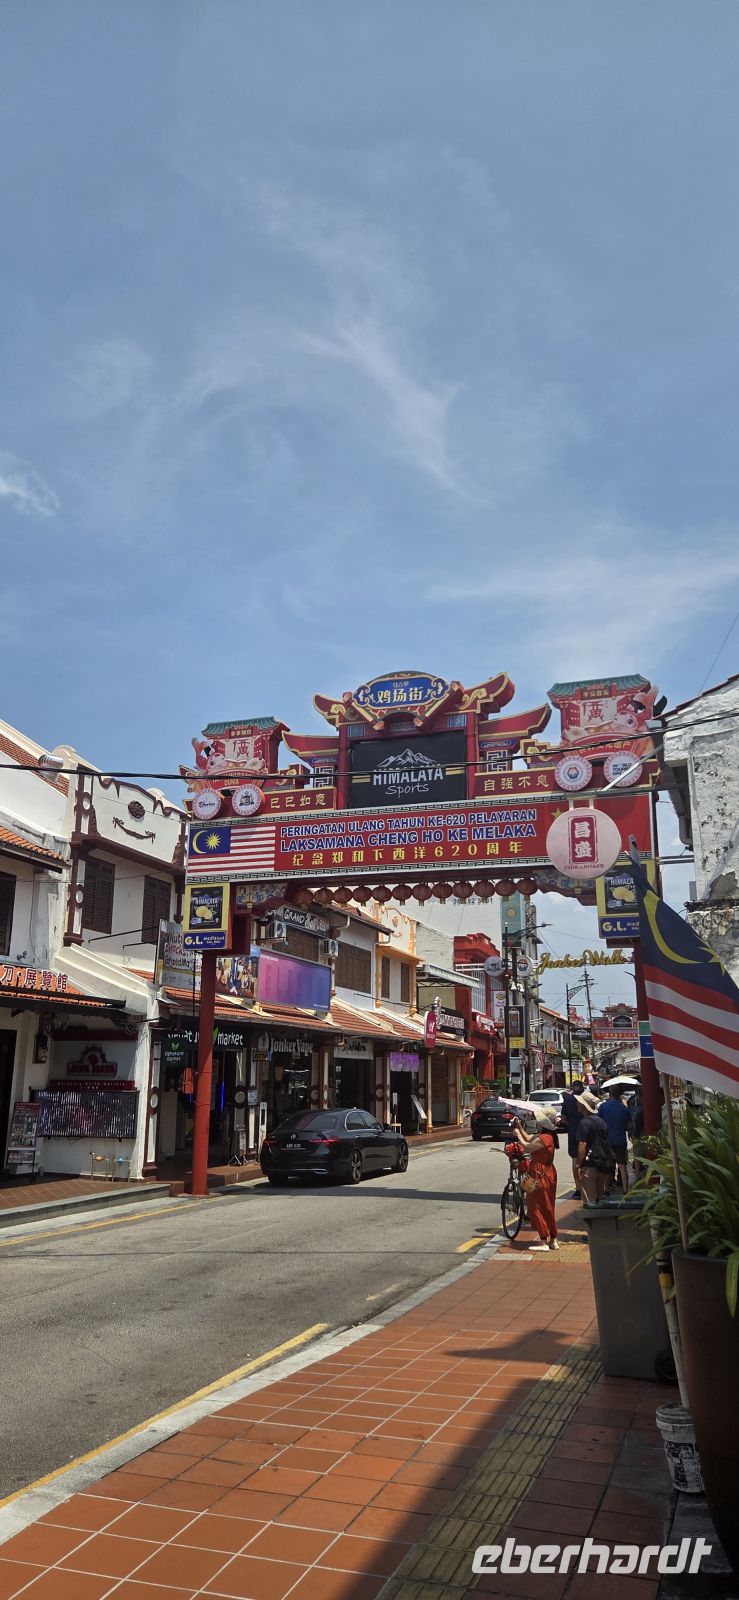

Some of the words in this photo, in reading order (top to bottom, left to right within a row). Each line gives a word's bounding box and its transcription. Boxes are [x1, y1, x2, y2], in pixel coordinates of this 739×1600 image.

[377, 686, 423, 704] 鸡场街
[373, 764, 443, 785] HIMALAYA
[483, 774, 550, 792] 自强不息
[386, 783, 429, 798] Sports
[281, 822, 345, 838] PERINGATAN
[347, 819, 385, 833] ULANG
[387, 817, 424, 831] TAHUN
[427, 814, 466, 828] KE-620
[468, 809, 537, 825] PELAYARAN
[280, 835, 365, 853] LAKSAMANA
[368, 831, 418, 846] CHENG
[422, 829, 444, 844] HO
[448, 827, 468, 842] KE
[472, 824, 537, 841] MELAKA
[284, 908, 305, 924] GRAND
[602, 921, 627, 932] G.L.
[185, 935, 203, 946] G.L.
[535, 952, 585, 975] Jonker
[583, 949, 625, 966] Walk
[217, 1031, 243, 1046] market
